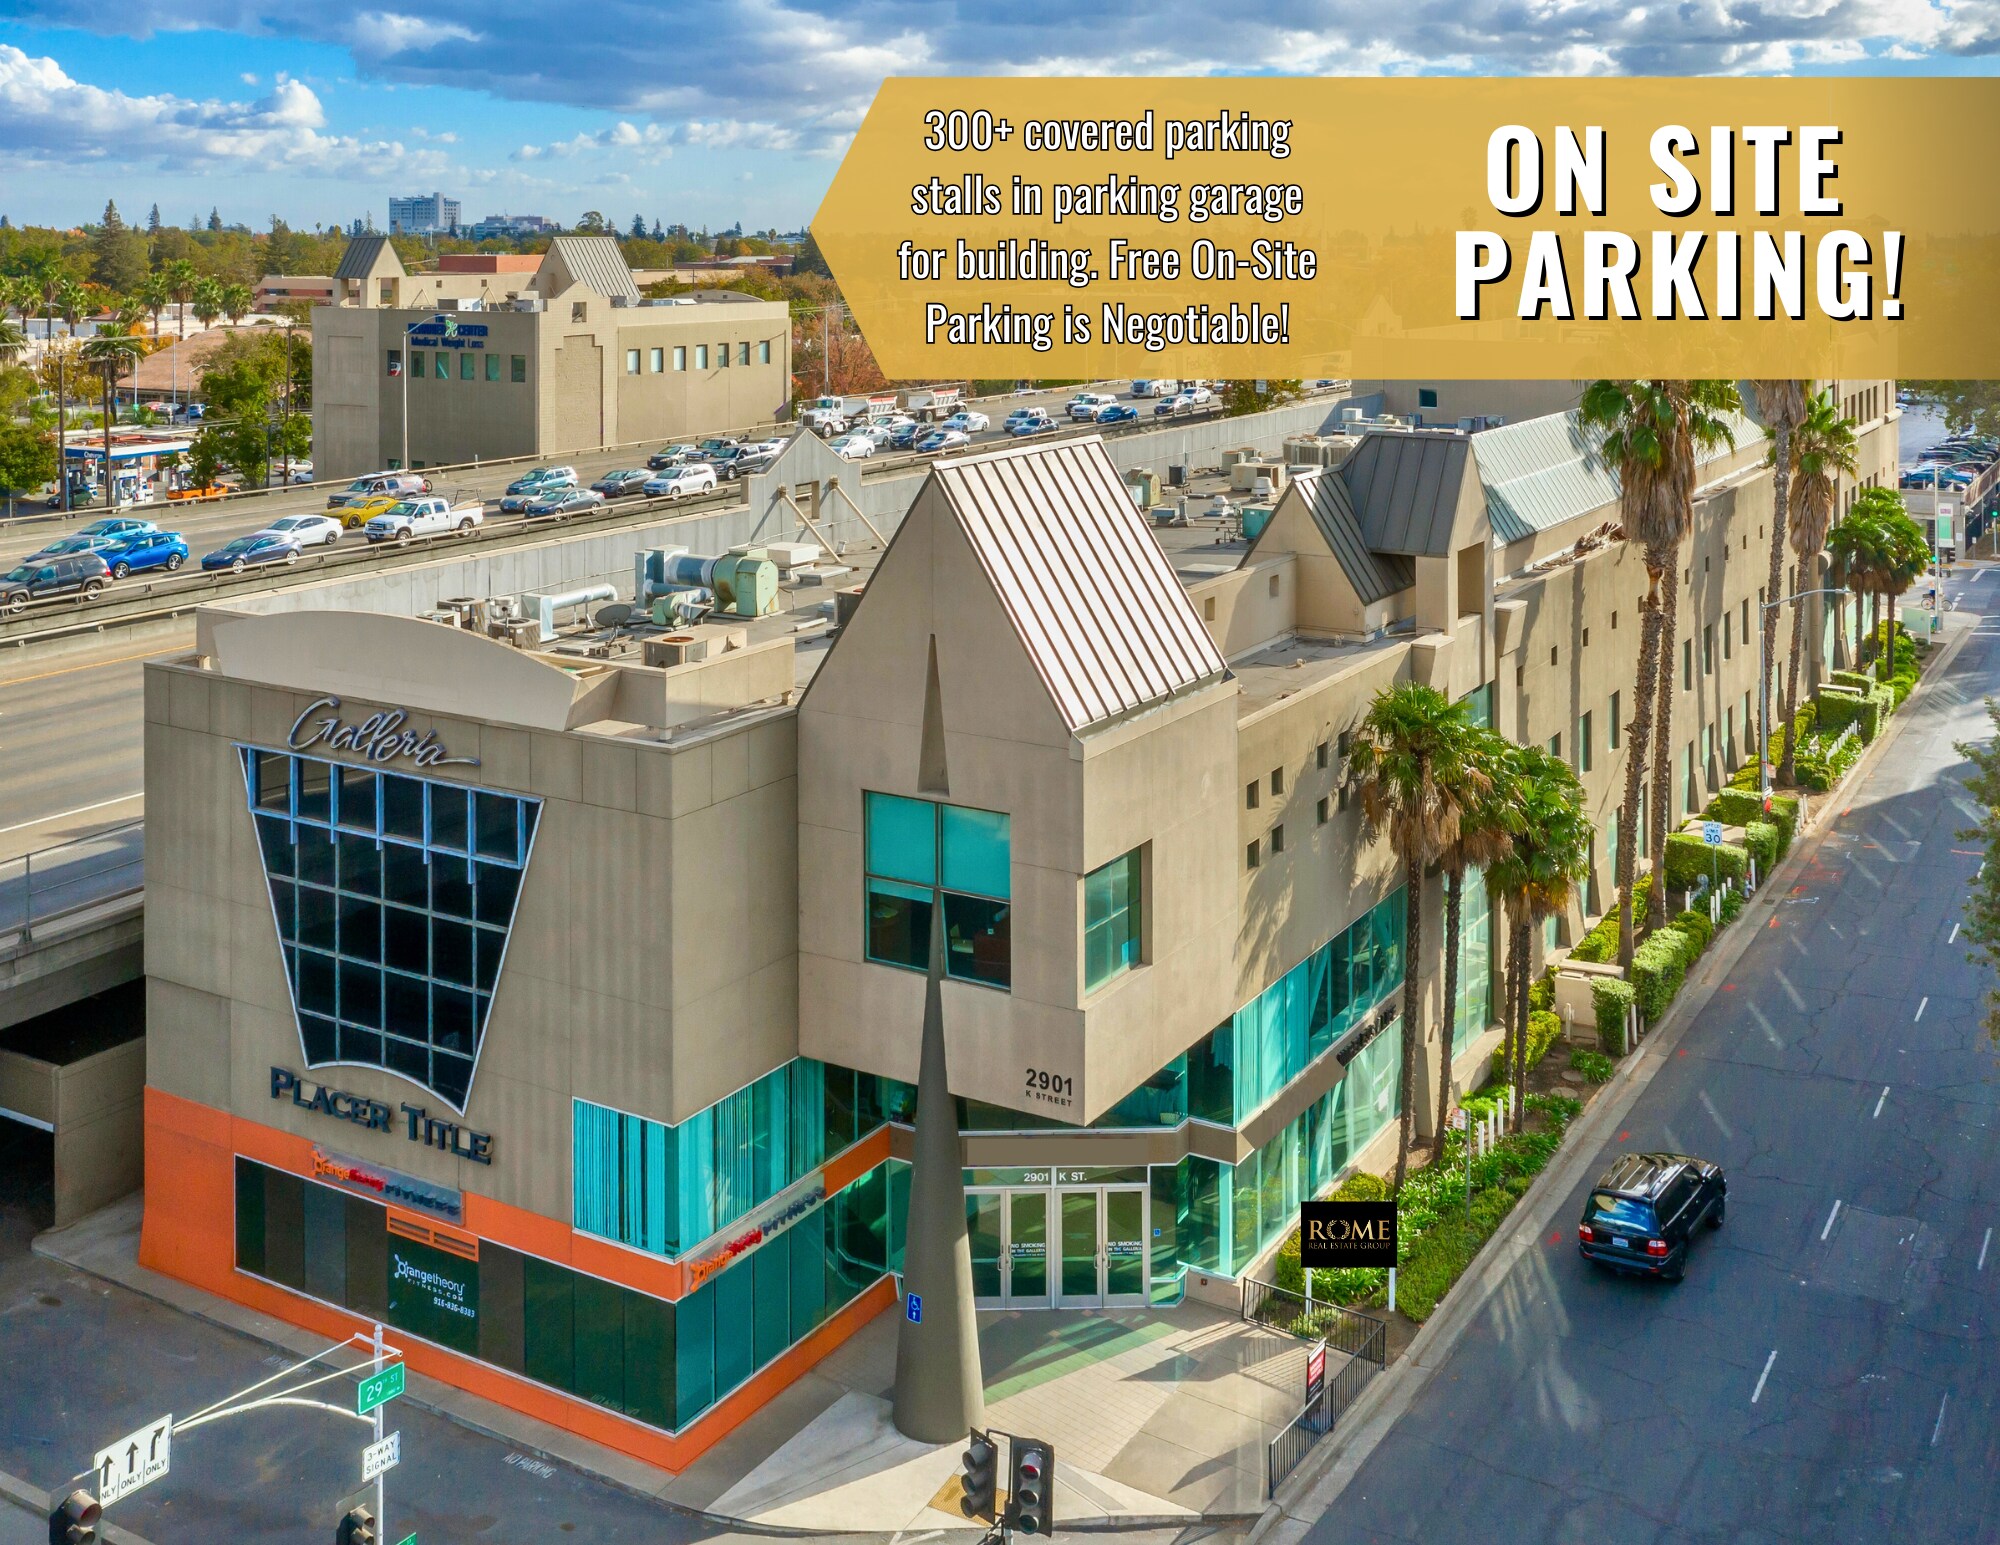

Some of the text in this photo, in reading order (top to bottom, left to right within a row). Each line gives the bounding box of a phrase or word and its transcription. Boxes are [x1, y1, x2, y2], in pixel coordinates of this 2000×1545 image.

[411, 336, 484, 350] Medical Weight Loss
[287, 696, 481, 767] Galleria
[1706, 834, 1720, 844] 30
[1026, 1068, 1072, 1096] 2901
[1036, 1092, 1072, 1107] STREET
[270, 1066, 492, 1165] PLACER TITLE
[1023, 1171, 1088, 1182] 2901 K ST.
[1308, 1219, 1391, 1241] ROME
[1308, 1241, 1391, 1250] REAL ESTATE GROUP
[394, 1253, 465, 1296] Orangetheory
[390, 1372, 398, 1383] ST
[367, 1439, 396, 1462] 3-WAY
[145, 1458, 166, 1476] ONLY
[366, 1452, 397, 1475] SIGNAL
[503, 1452, 558, 1479] NO PARKING
[121, 1471, 142, 1490] ONLY
[101, 1485, 116, 1500] NLY
